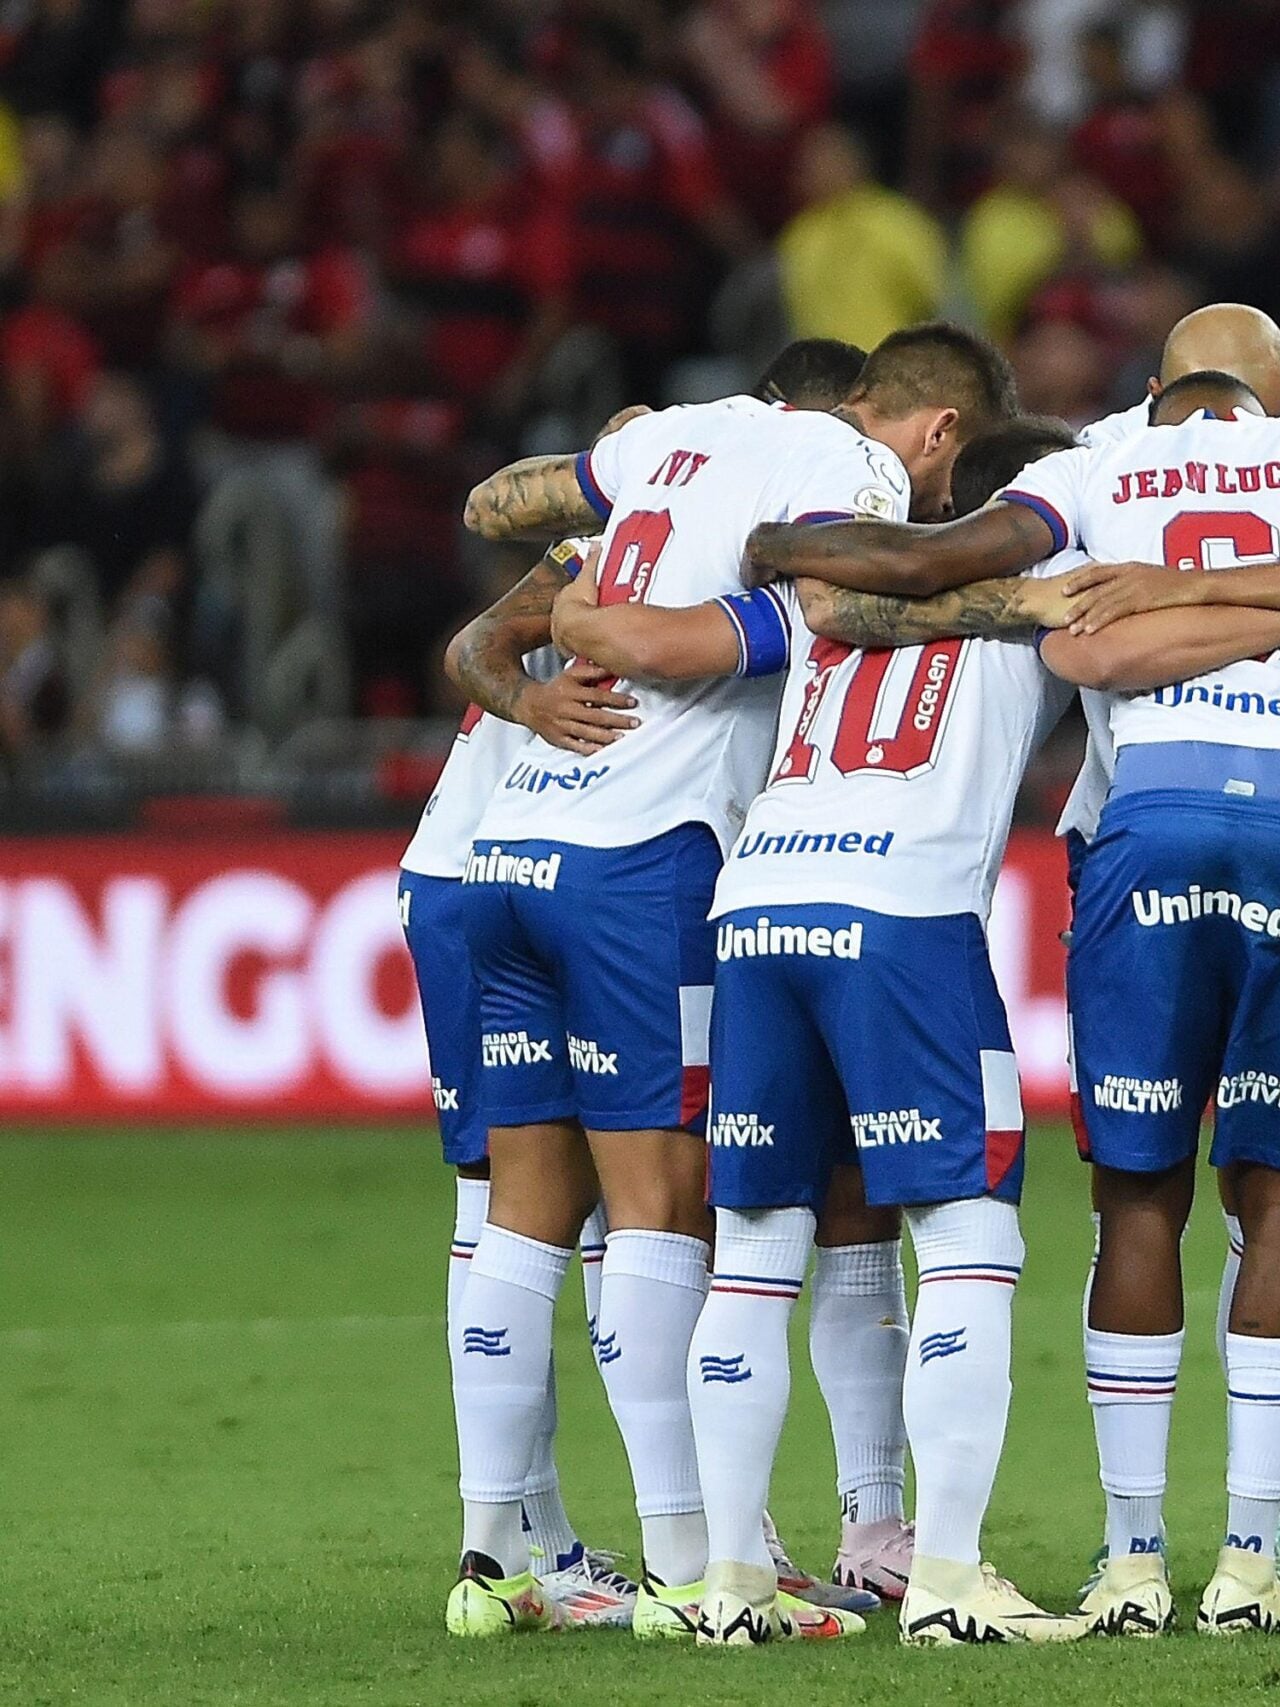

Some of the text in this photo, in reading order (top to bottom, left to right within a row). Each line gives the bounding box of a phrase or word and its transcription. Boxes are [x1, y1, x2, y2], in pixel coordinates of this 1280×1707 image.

[1112, 461, 1209, 504] JEAN
[765, 636, 972, 793] 10
[913, 652, 951, 732] acelen
[736, 830, 895, 859] Unimed
[715, 917, 864, 961] Unimed
[0, 868, 430, 1096] NGO
